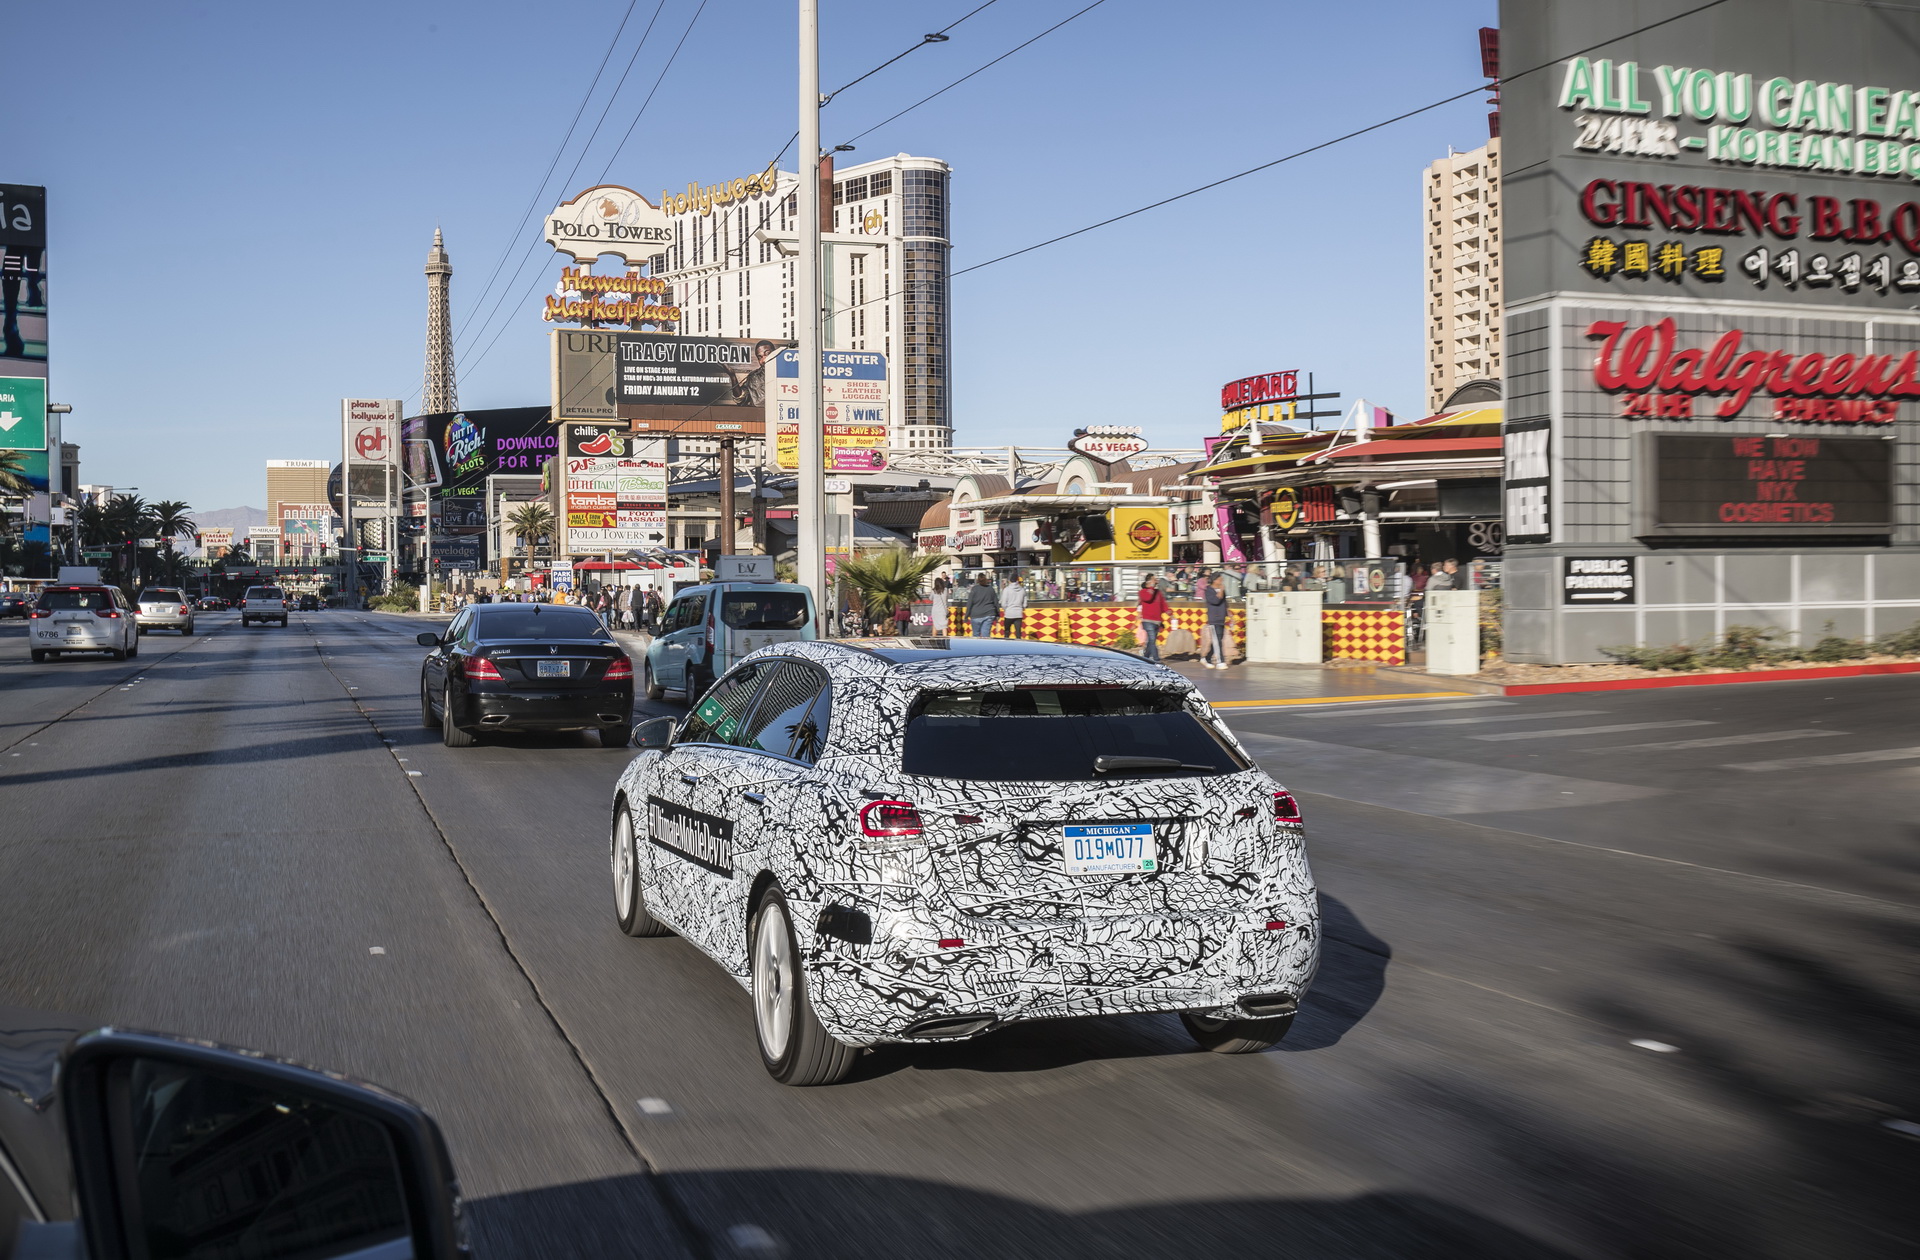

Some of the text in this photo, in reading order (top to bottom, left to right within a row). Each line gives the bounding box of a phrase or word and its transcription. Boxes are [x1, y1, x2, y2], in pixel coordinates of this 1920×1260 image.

[1558, 56, 1651, 114] ALL
[1654, 65, 1752, 124] YOU
[1758, 76, 1853, 134] CAN
[1707, 124, 1854, 173] KOREAN
[662, 162, 776, 217] hollywood
[1580, 178, 1802, 238] GINSENG
[552, 219, 673, 241] POLO TOWERS
[1587, 239, 1725, 276] 韓國料理
[562, 266, 669, 296] Hawaiian
[545, 295, 681, 325] Marketplace
[620, 342, 752, 364] TRACY MORGAN
[828, 354, 879, 365] CENTER
[644, 366, 661, 374] STAGE
[822, 367, 853, 376] HOPS
[1586, 317, 1920, 420] Walgreens
[624, 385, 700, 396] FRIDAY JANUARY 12
[351, 400, 380, 409] planet
[852, 407, 884, 421] WINE
[452, 423, 475, 441] HIT IT
[574, 426, 598, 436] chili's
[826, 426, 849, 435] HERE!
[446, 427, 486, 467] Rich!
[778, 435, 795, 444] Grand
[832, 437, 848, 445] Vegas
[1084, 443, 1140, 452] LAS VEGAS
[1732, 438, 1820, 457] WE NOW
[460, 457, 485, 473] SLOTS
[498, 456, 528, 468] FOR
[618, 460, 641, 468] China
[1747, 460, 1806, 480] HAVE
[1756, 481, 1799, 501] NYX
[569, 494, 616, 505] tamba
[1718, 502, 1835, 523] COSMETICS
[1189, 514, 1214, 531] SHIRT
[570, 529, 645, 540] POLO TOWERS
[431, 546, 475, 557] ravelodge
[1570, 559, 1629, 573] PUBLIC
[649, 803, 733, 871] #UltimateMobileDevice
[1086, 826, 1131, 835] MICHIGAN
[1074, 837, 1144, 861] 019M077
[1086, 863, 1136, 871] MANUFACTURER
